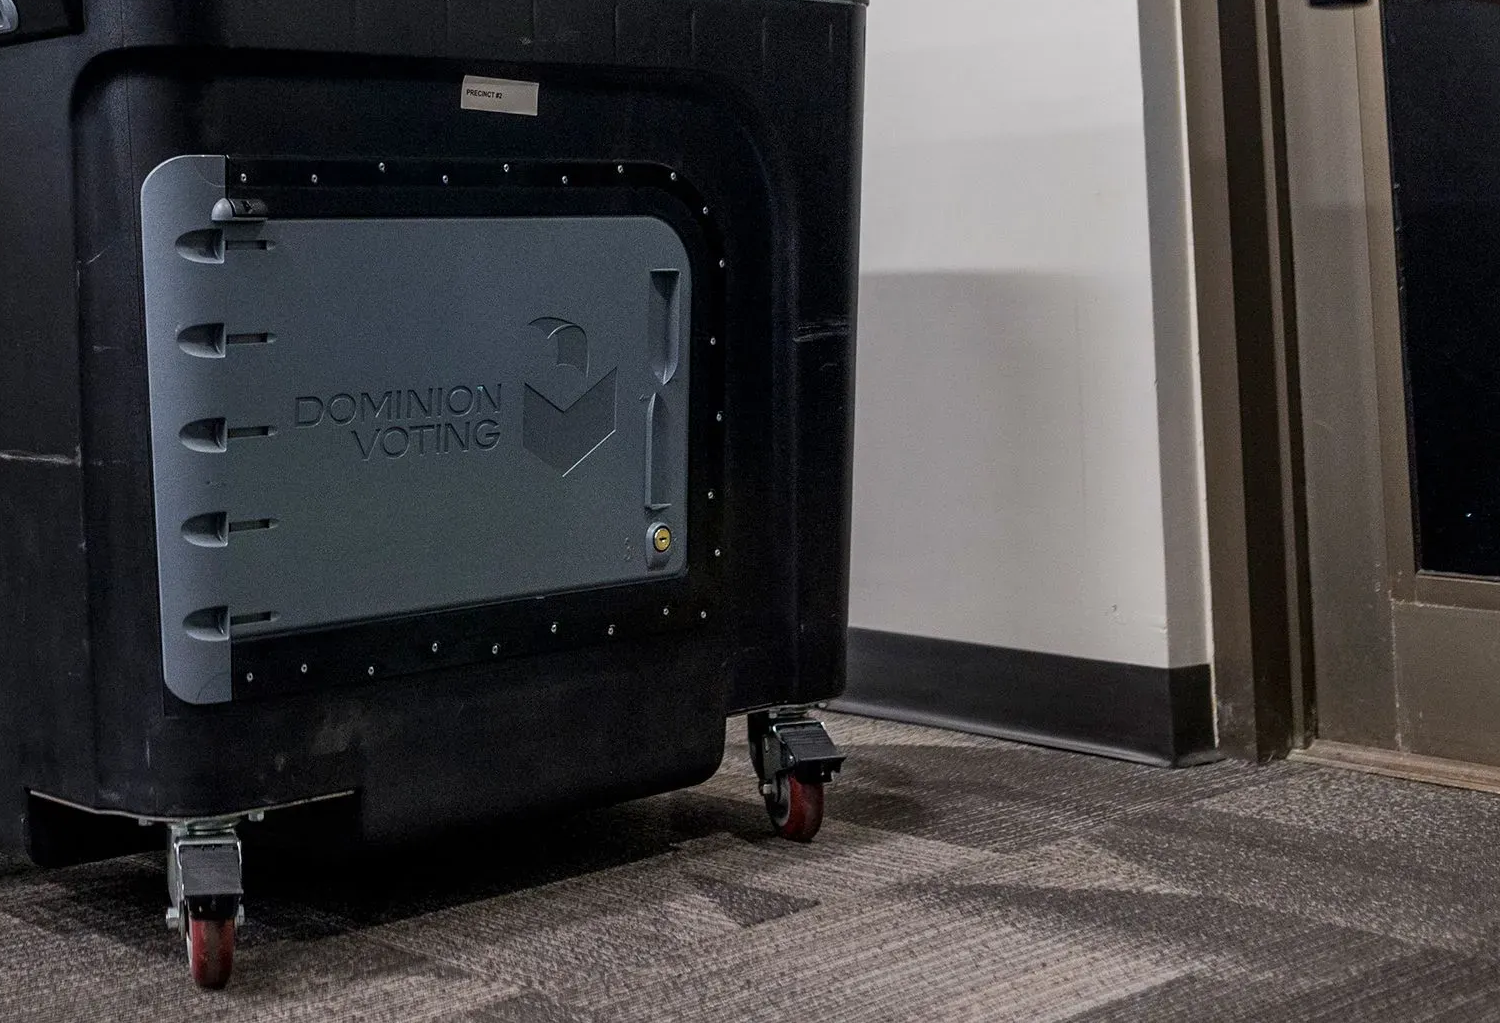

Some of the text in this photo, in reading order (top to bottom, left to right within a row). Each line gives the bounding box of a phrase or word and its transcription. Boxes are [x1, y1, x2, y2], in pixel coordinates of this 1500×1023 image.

[466, 89, 495, 98] PRECINCT
[294, 383, 502, 429] DOMINION
[351, 419, 501, 462] VOTING
